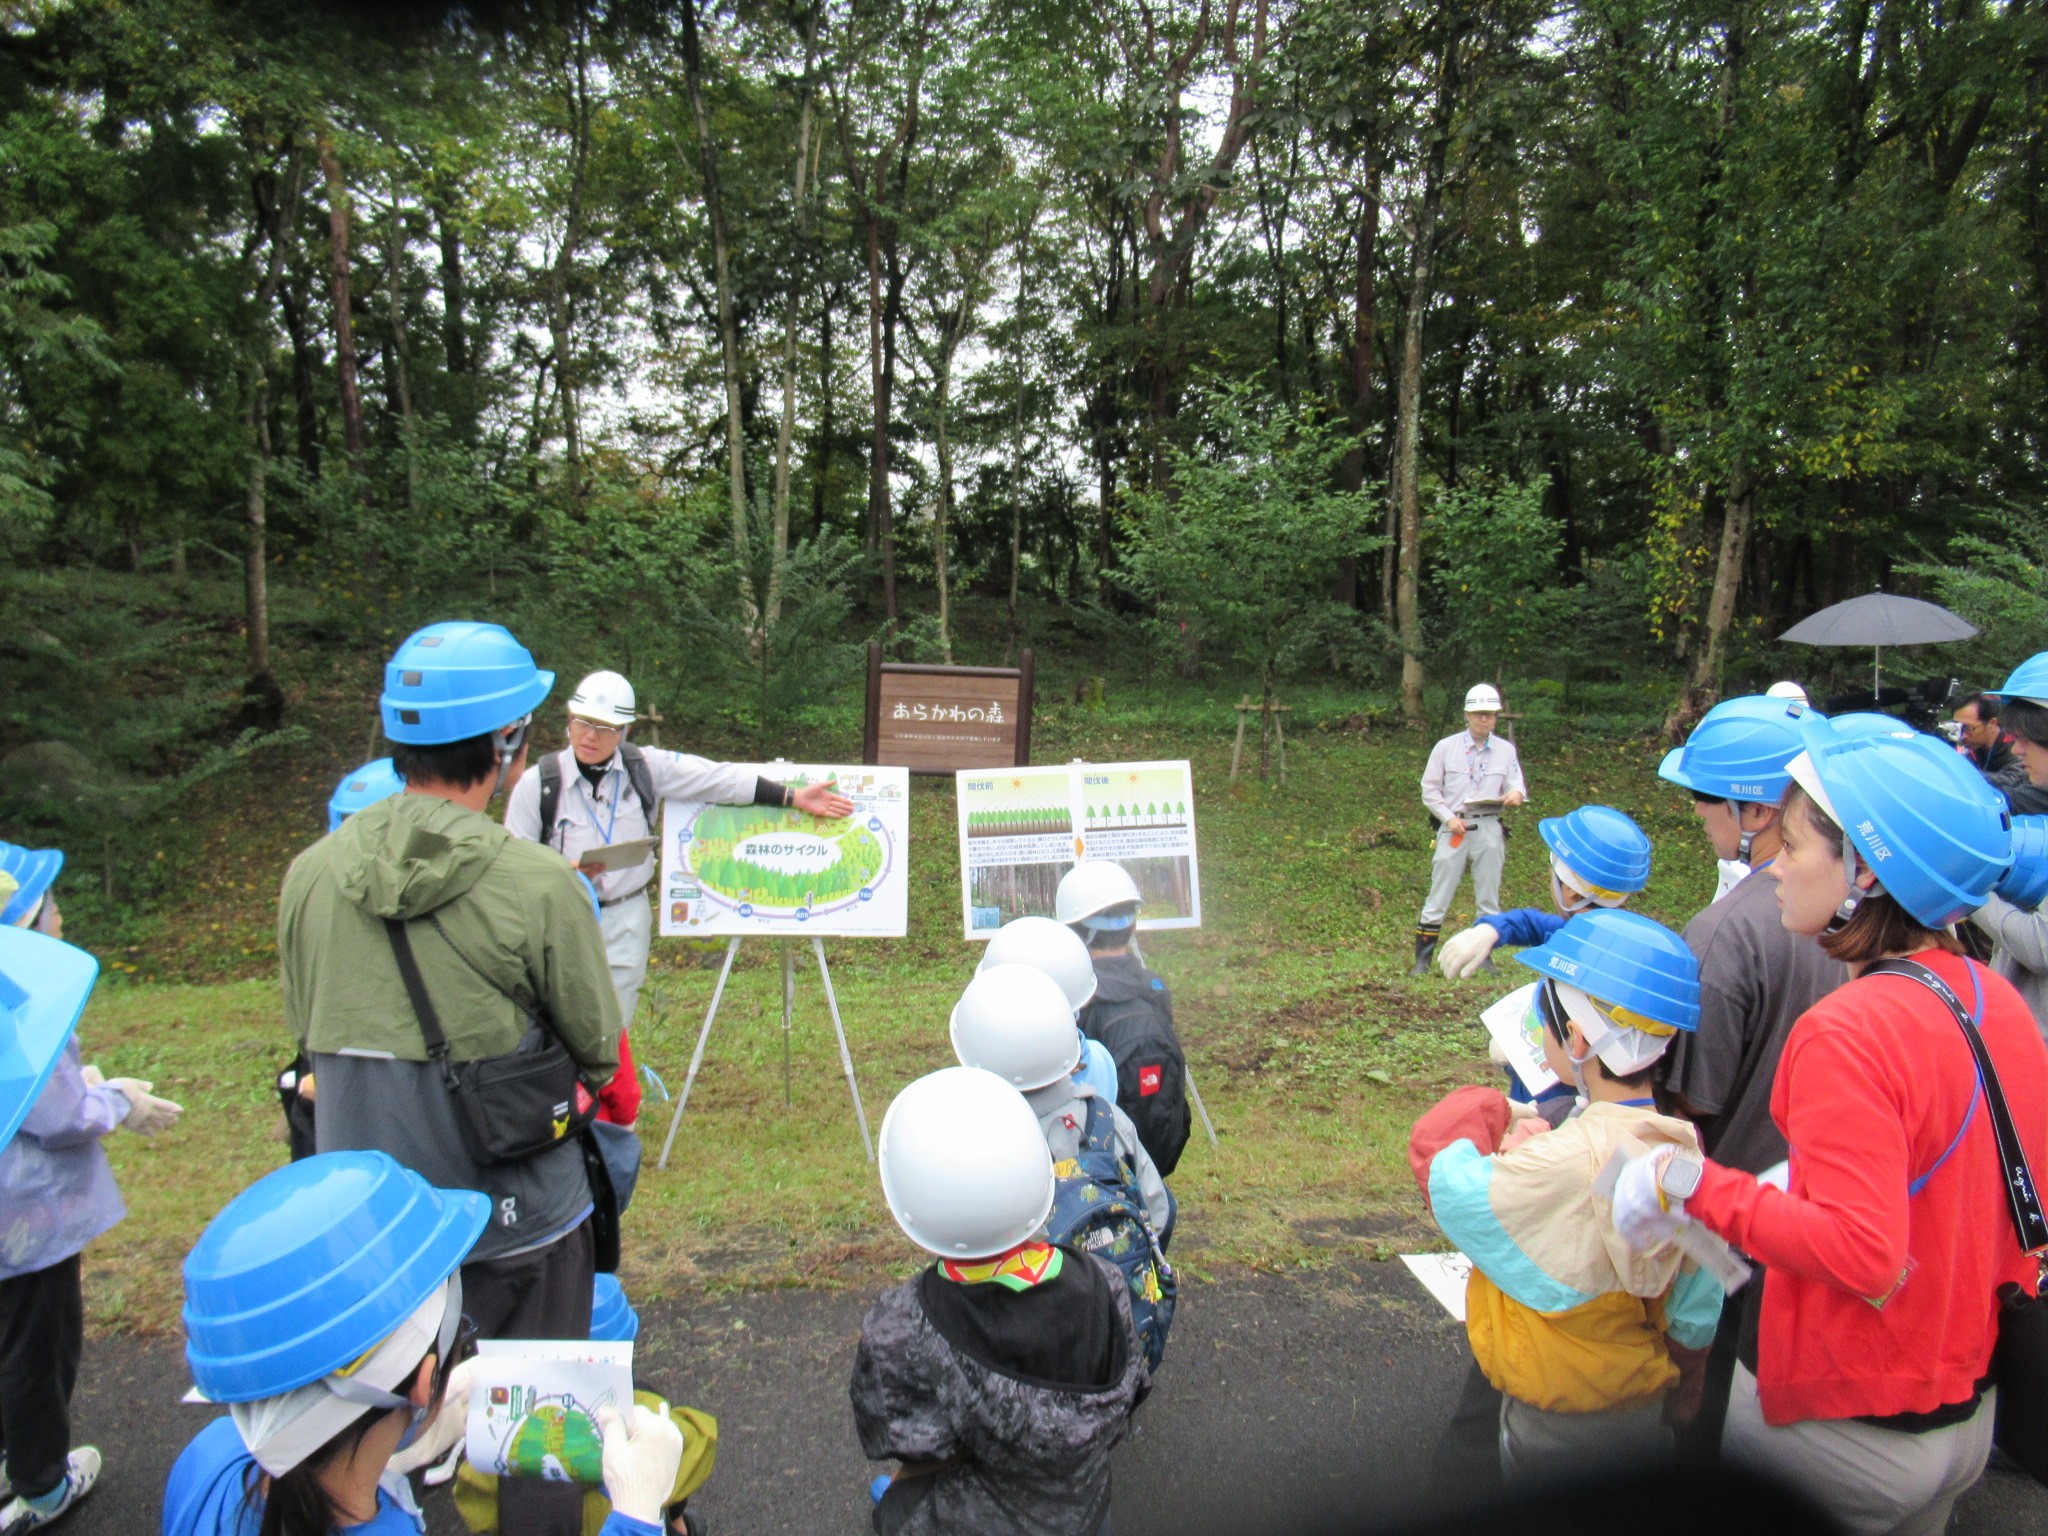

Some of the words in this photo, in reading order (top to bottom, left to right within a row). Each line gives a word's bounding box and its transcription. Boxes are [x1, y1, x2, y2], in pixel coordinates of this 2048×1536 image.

[893, 701, 1004, 724] あらかわの森
[968, 781, 993, 791] 間伐前
[1083, 775, 1109, 786] 間伐後
[1730, 783, 1764, 796] 荒川区
[1855, 820, 1893, 862] 荒川区
[745, 843, 828, 856] 森林のサイクル
[1548, 956, 1578, 977] 荒川区
